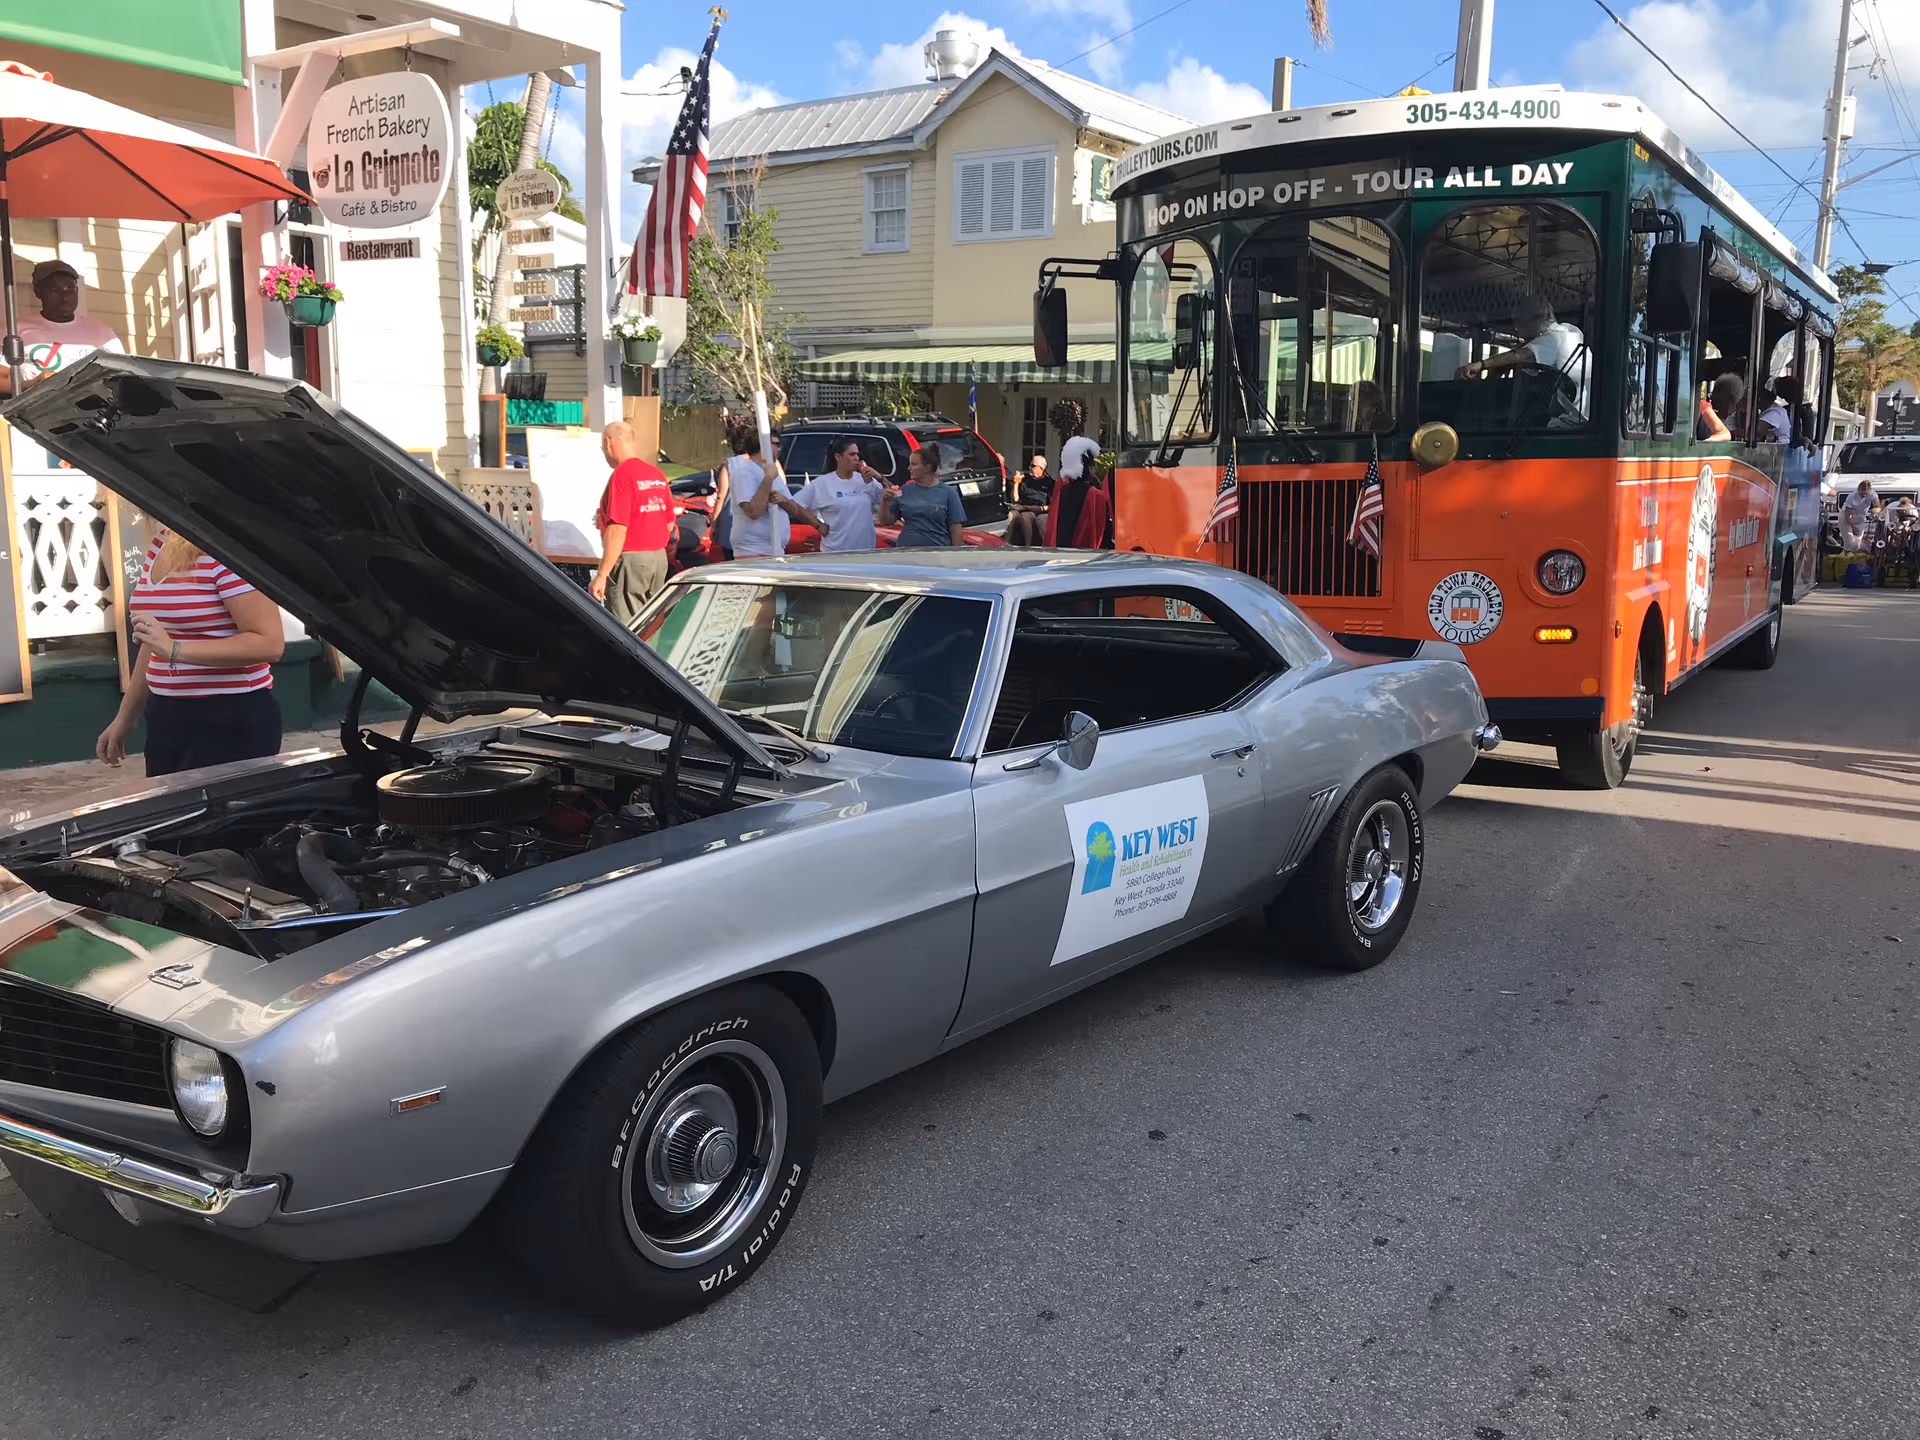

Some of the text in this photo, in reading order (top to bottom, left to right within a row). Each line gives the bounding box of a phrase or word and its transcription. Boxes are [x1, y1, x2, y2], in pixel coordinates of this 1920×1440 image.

[348, 93, 405, 116] Artisan
[1406, 99, 1561, 125] 305-434-4900
[327, 115, 431, 144] French Bakery
[1116, 130, 1218, 181] TROLLEYTOURS.COM
[334, 144, 440, 196] La Grignote
[1147, 202, 1180, 228] HOP
[1184, 194, 1208, 219] ON
[1212, 186, 1265, 212] HOP
[1273, 178, 1326, 204] OFF
[1352, 167, 1435, 195] TOUR
[1443, 165, 1501, 188] ALL
[1511, 162, 1574, 186] DAY
[341, 200, 418, 217] Café & Bistro
[346, 239, 414, 260] Restaurant
[518, 255, 541, 269] Pizza
[513, 280, 546, 295] COFFEE
[510, 307, 554, 322] Breakfast
[1429, 572, 1503, 616] OLD TOWN TROLLEY
[1438, 620, 1491, 644] TOURS
[1121, 816, 1198, 862] KEY WEST
[1400, 791, 1422, 882] Radial T/A
[1119, 861, 1140, 877] Health
[1140, 856, 1153, 871] and
[1142, 870, 1166, 884] College
[1165, 863, 1181, 877] Road
[1114, 896, 1127, 907] Key
[1144, 882, 1166, 897] Florida
[611, 1017, 749, 1169] BFGoodrich
[699, 1163, 801, 1292] Radial T/A
